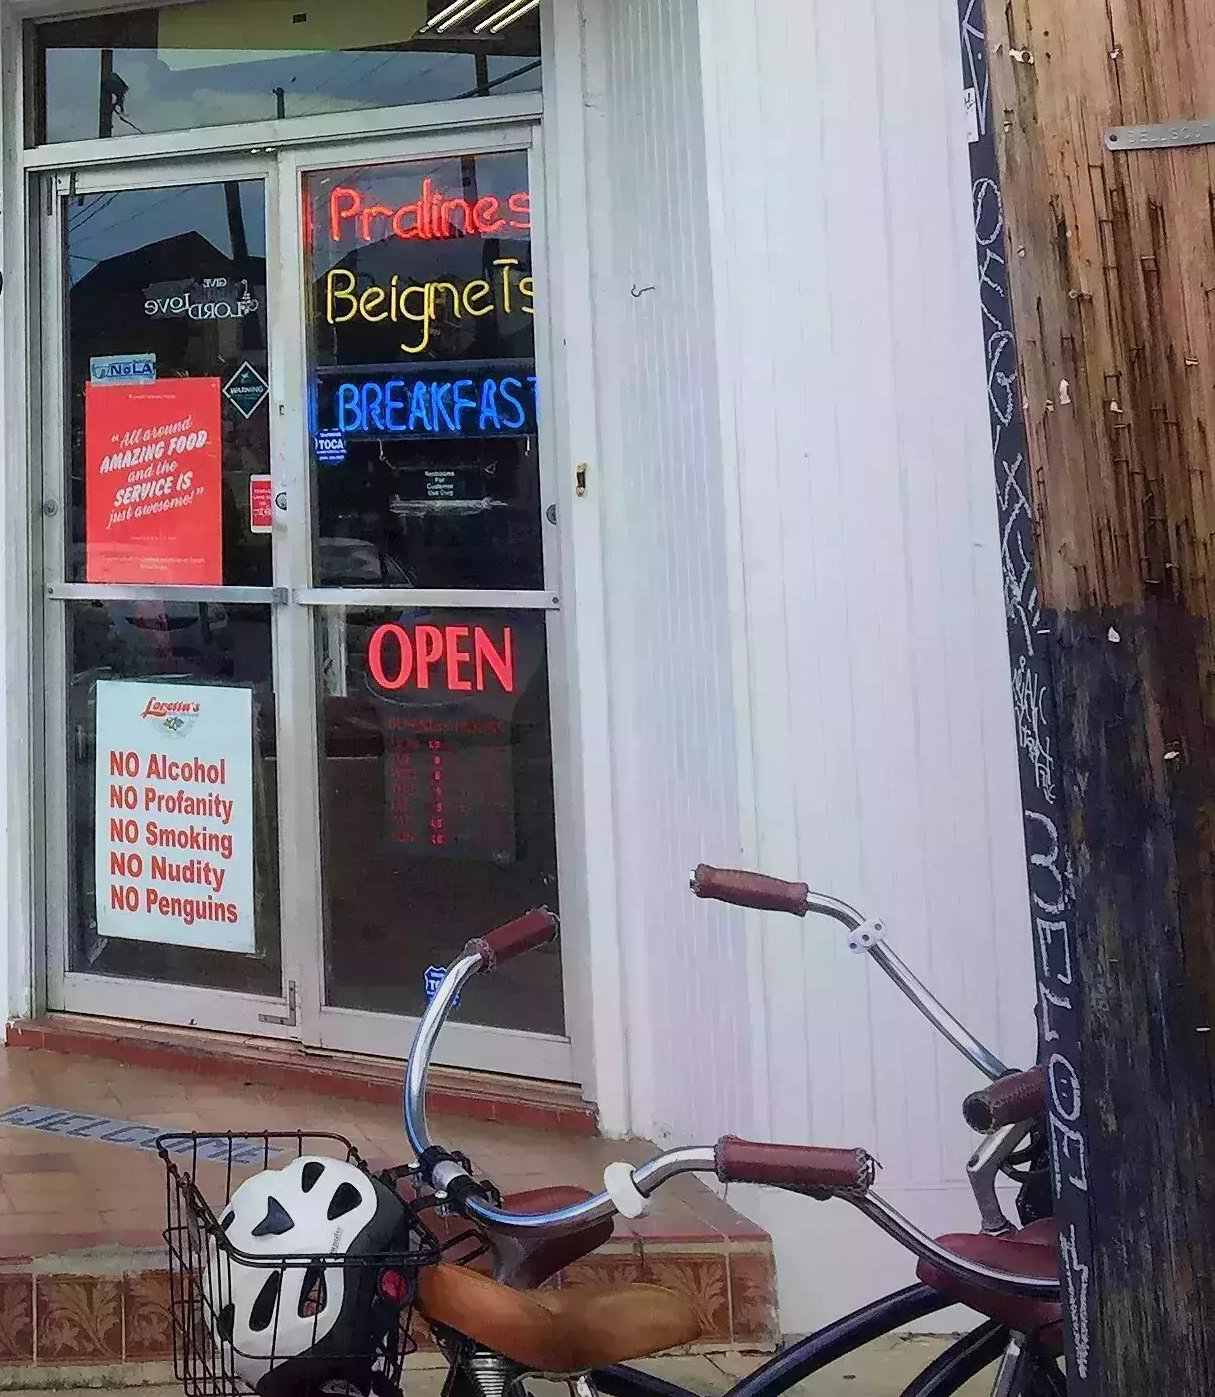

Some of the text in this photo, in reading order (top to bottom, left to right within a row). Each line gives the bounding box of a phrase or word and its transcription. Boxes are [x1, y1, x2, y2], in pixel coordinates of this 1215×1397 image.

[329, 178, 531, 241] Pralines
[142, 415, 192, 443] around
[318, 439, 344, 450] TOCA
[99, 430, 208, 474] AMAZING FOOD
[127, 458, 178, 482] and the
[114, 471, 193, 507] SERVICE IS
[106, 507, 133, 530] just
[368, 623, 513, 692] OPEN
[109, 751, 226, 784] NO Alcohol
[109, 784, 234, 824] NO Profanity
[109, 818, 233, 859] NO Smoking
[110, 851, 225, 893] NO Nudity
[110, 884, 238, 925] NO Penguins
